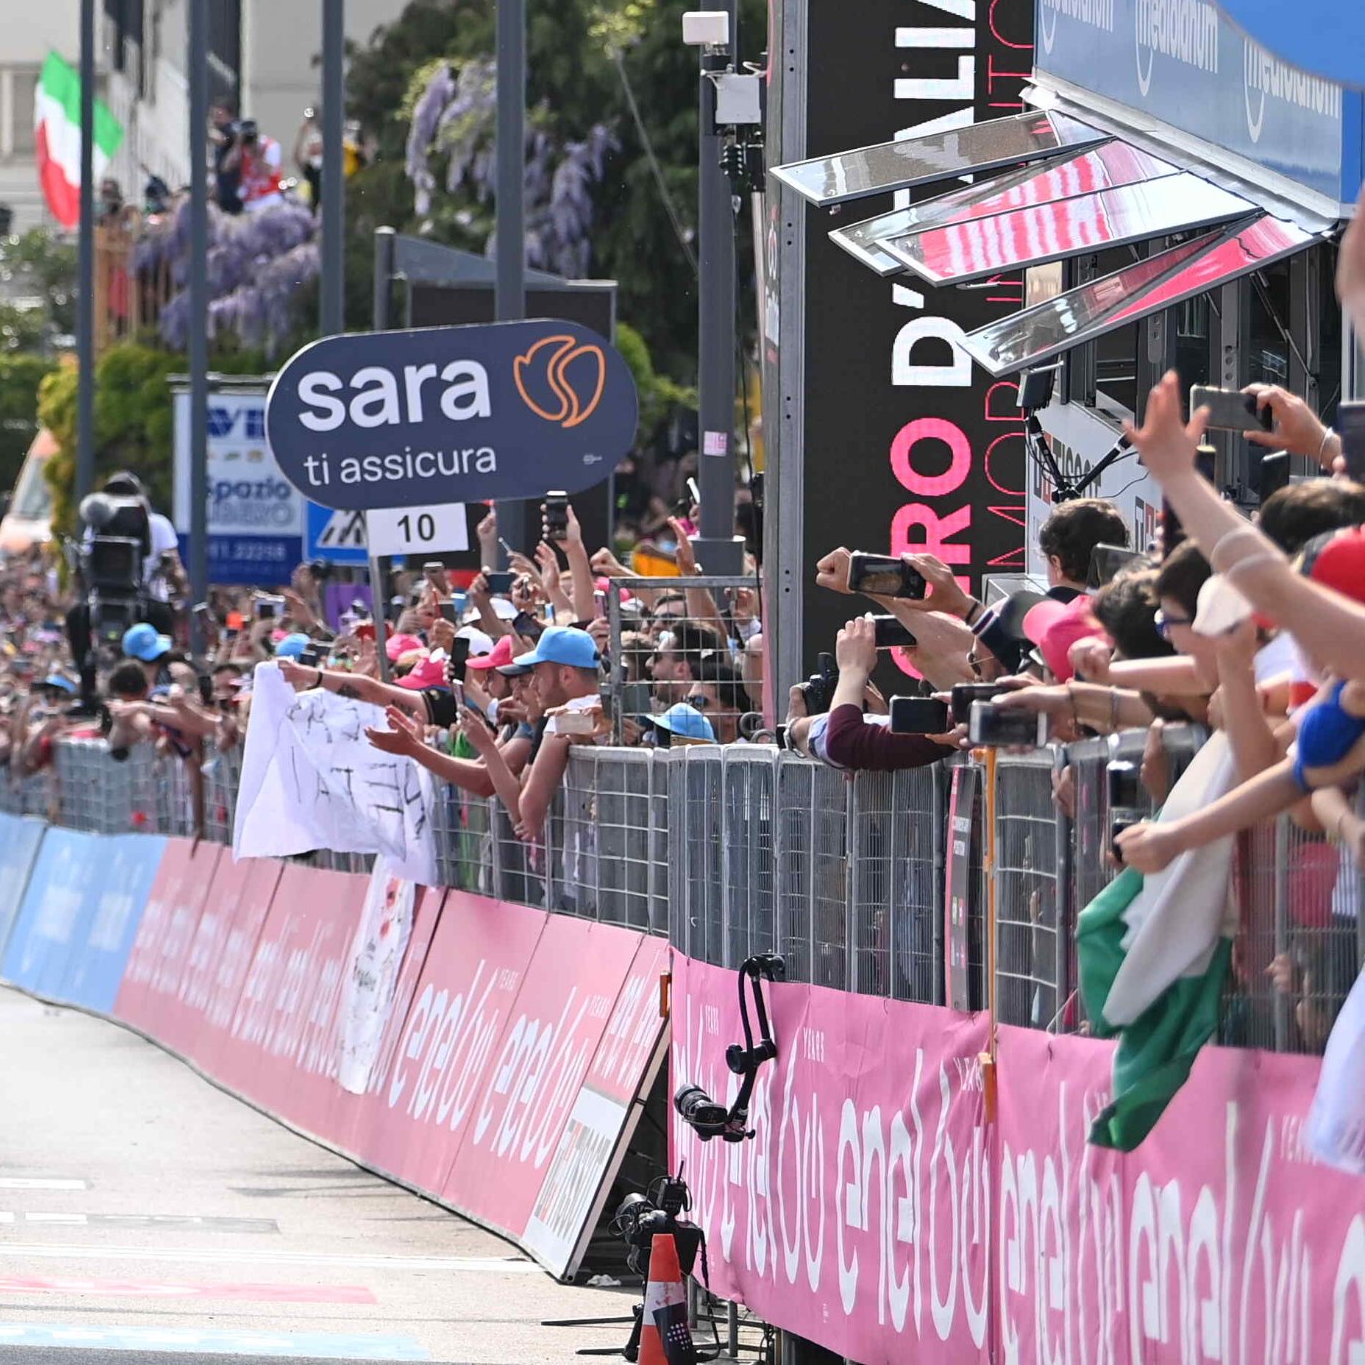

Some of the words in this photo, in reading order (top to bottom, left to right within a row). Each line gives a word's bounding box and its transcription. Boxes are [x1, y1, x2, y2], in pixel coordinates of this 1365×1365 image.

[297, 359, 491, 433] sara
[302, 450, 330, 486] ti
[340, 445, 498, 485] assicura
[396, 513, 436, 545] 10
[388, 959, 486, 1124] enel
[473, 985, 577, 1163] enel
[836, 1048, 924, 1340] enel
